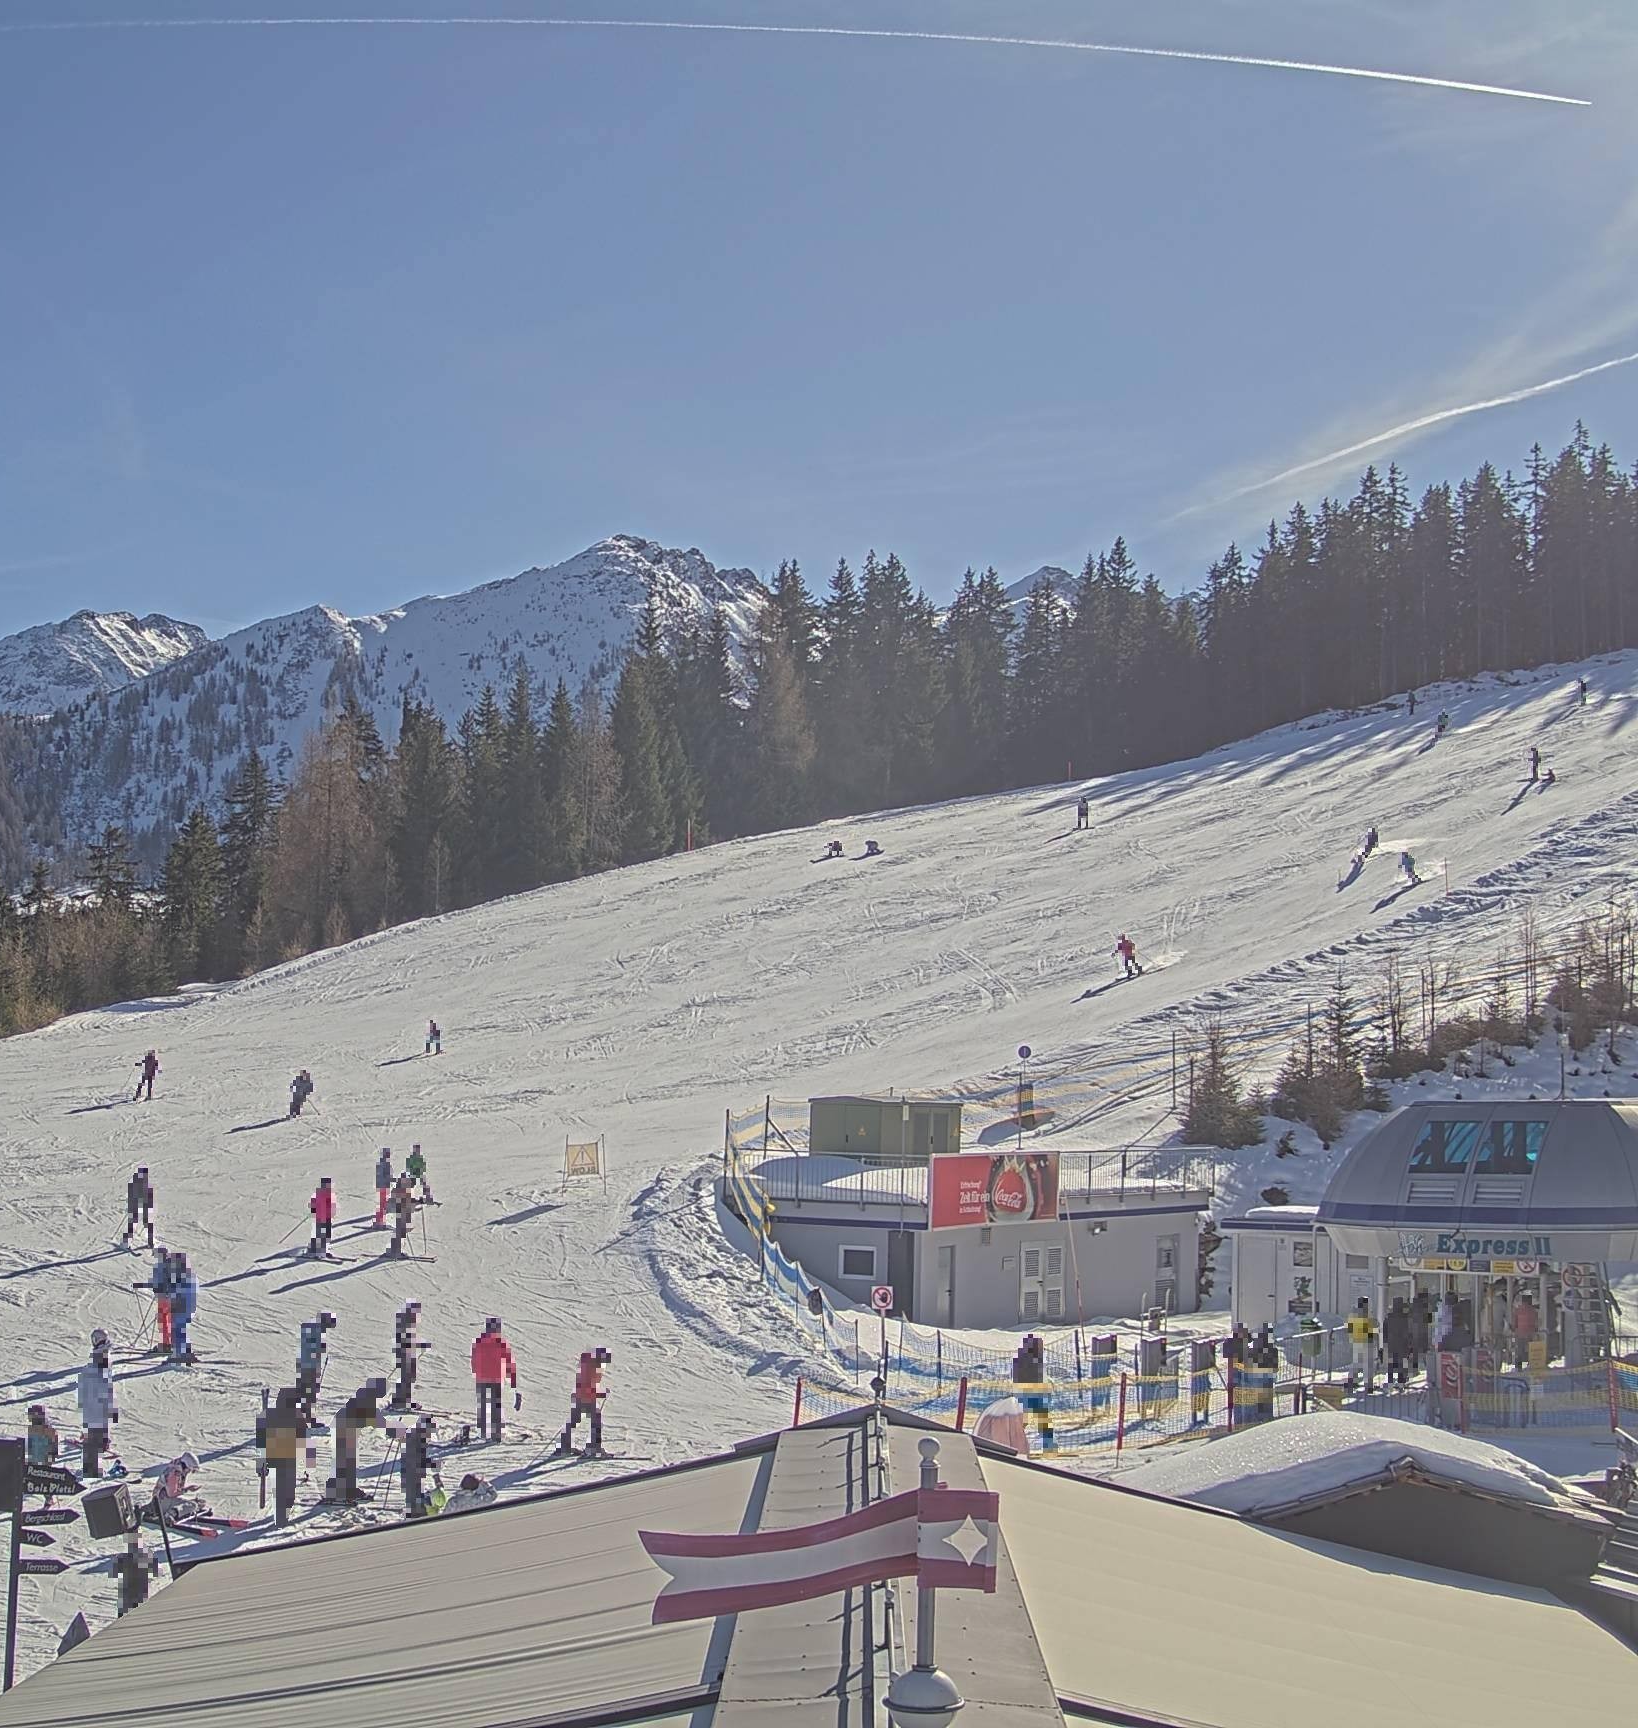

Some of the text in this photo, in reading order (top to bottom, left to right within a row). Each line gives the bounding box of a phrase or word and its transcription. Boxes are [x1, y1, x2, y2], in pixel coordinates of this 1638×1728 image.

[1436, 1234, 1530, 1259] Express
[1534, 1236, 1552, 1256] II
[27, 1466, 66, 1480] Restaurant
[27, 1533, 44, 1543] WC
[25, 1563, 59, 1573] Terrasse
